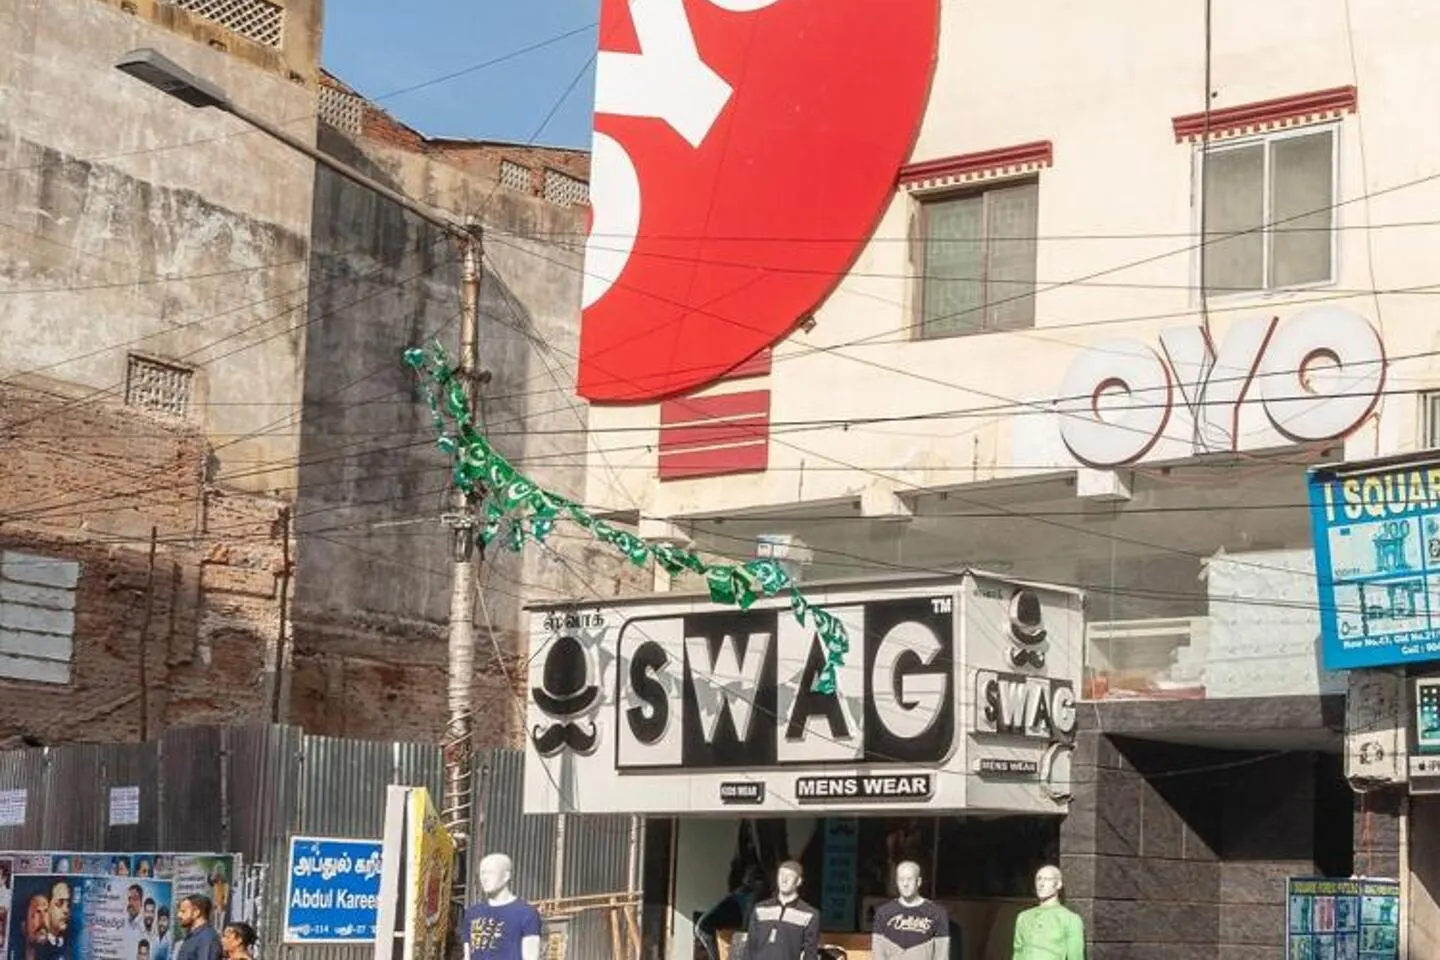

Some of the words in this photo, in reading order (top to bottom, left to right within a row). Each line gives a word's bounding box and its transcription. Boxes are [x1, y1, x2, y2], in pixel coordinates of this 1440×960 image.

[1058, 305, 1387, 470] OYO
[930, 597, 952, 614] TM
[626, 620, 948, 745] SWAG
[984, 680, 1077, 734] SWAG
[798, 778, 858, 795] MENS
[863, 776, 927, 794] WEAR
[291, 888, 333, 909] Abdul
